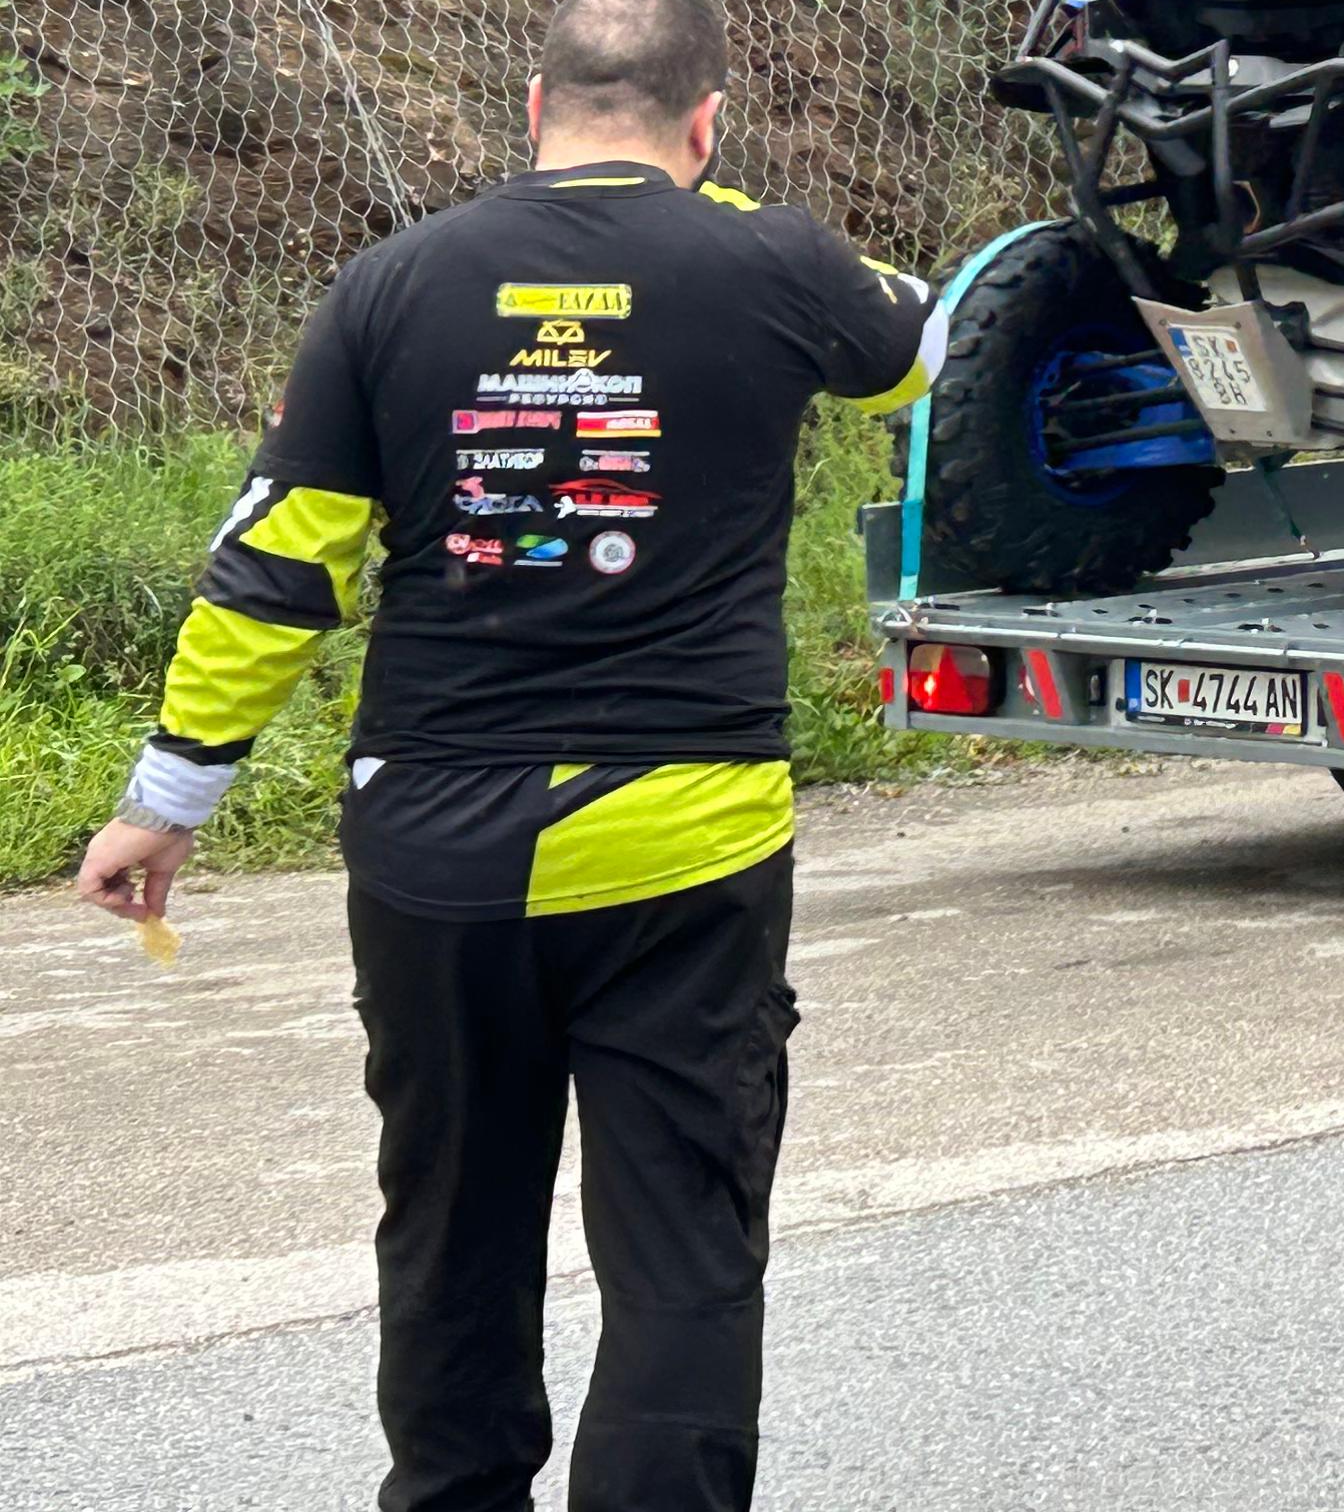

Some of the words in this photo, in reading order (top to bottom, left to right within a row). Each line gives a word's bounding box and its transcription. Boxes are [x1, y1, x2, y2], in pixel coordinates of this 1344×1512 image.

[1192, 335, 1221, 358] SK
[509, 349, 612, 368] MILEV
[1145, 669, 1175, 710] SK
[1192, 672, 1259, 717] 4744
[1265, 677, 1298, 719] AN
